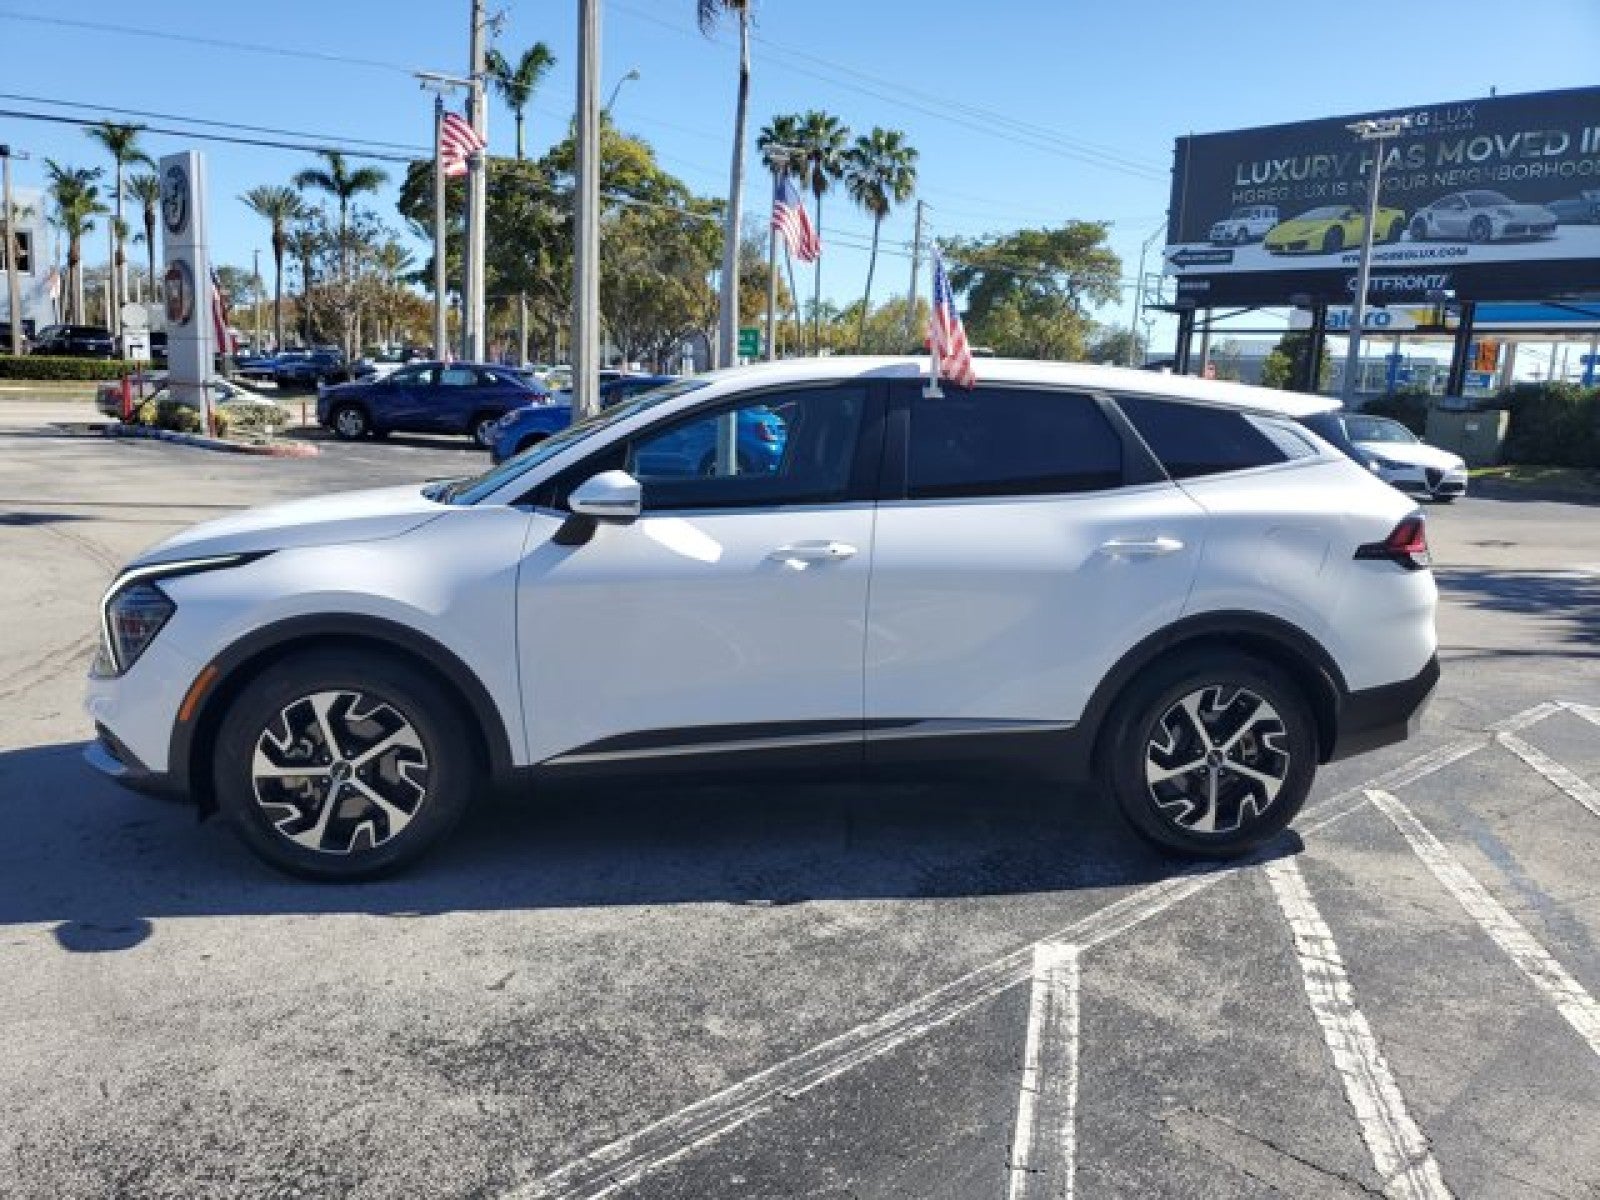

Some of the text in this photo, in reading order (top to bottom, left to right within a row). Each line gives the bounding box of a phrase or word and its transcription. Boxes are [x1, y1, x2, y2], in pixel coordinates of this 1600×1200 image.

[1434, 104, 1477, 124] LUX
[1236, 153, 1350, 186] LUXURY
[1359, 144, 1426, 176] HAS
[1436, 129, 1571, 166] MOVED
[1232, 186, 1289, 205] HGREG
[1332, 181, 1349, 197] IS
